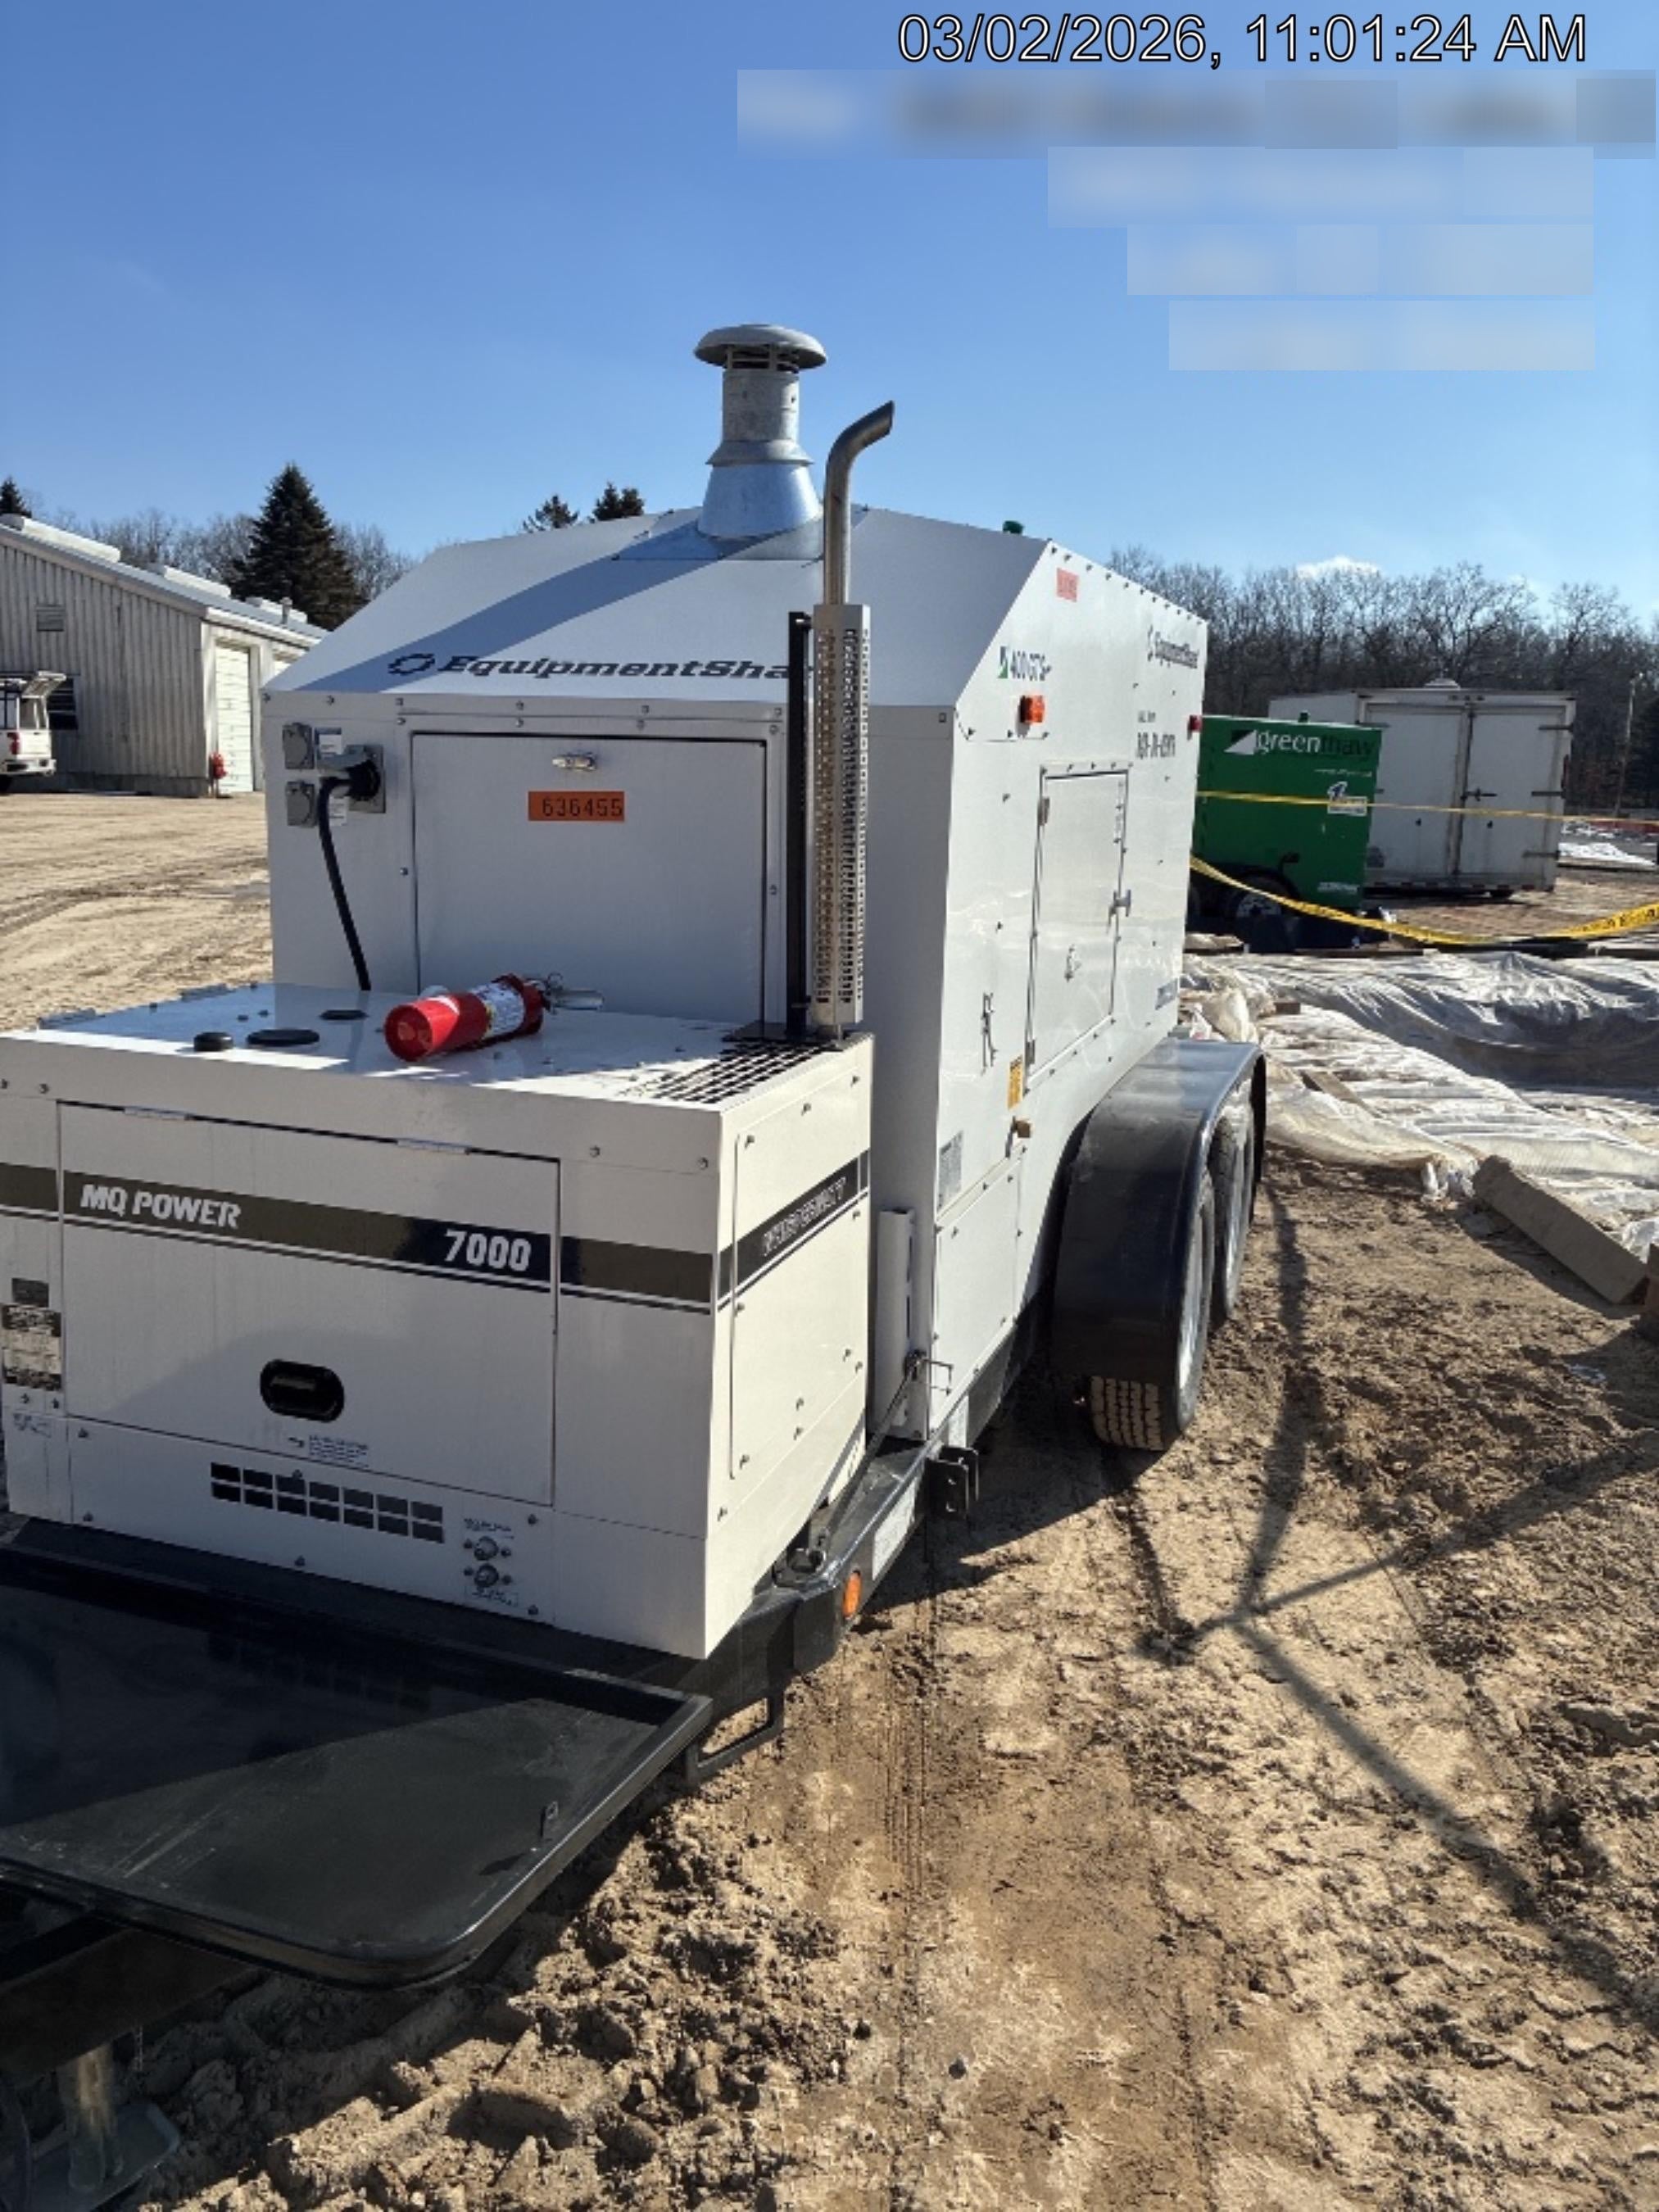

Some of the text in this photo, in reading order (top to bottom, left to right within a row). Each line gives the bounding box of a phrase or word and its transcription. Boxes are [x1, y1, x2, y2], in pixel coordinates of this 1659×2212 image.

[436, 655, 814, 679] EquipmentSha
[542, 798, 623, 817] 636455
[81, 1185, 241, 1228] MQ POWER
[443, 1229, 531, 1271] 7000
